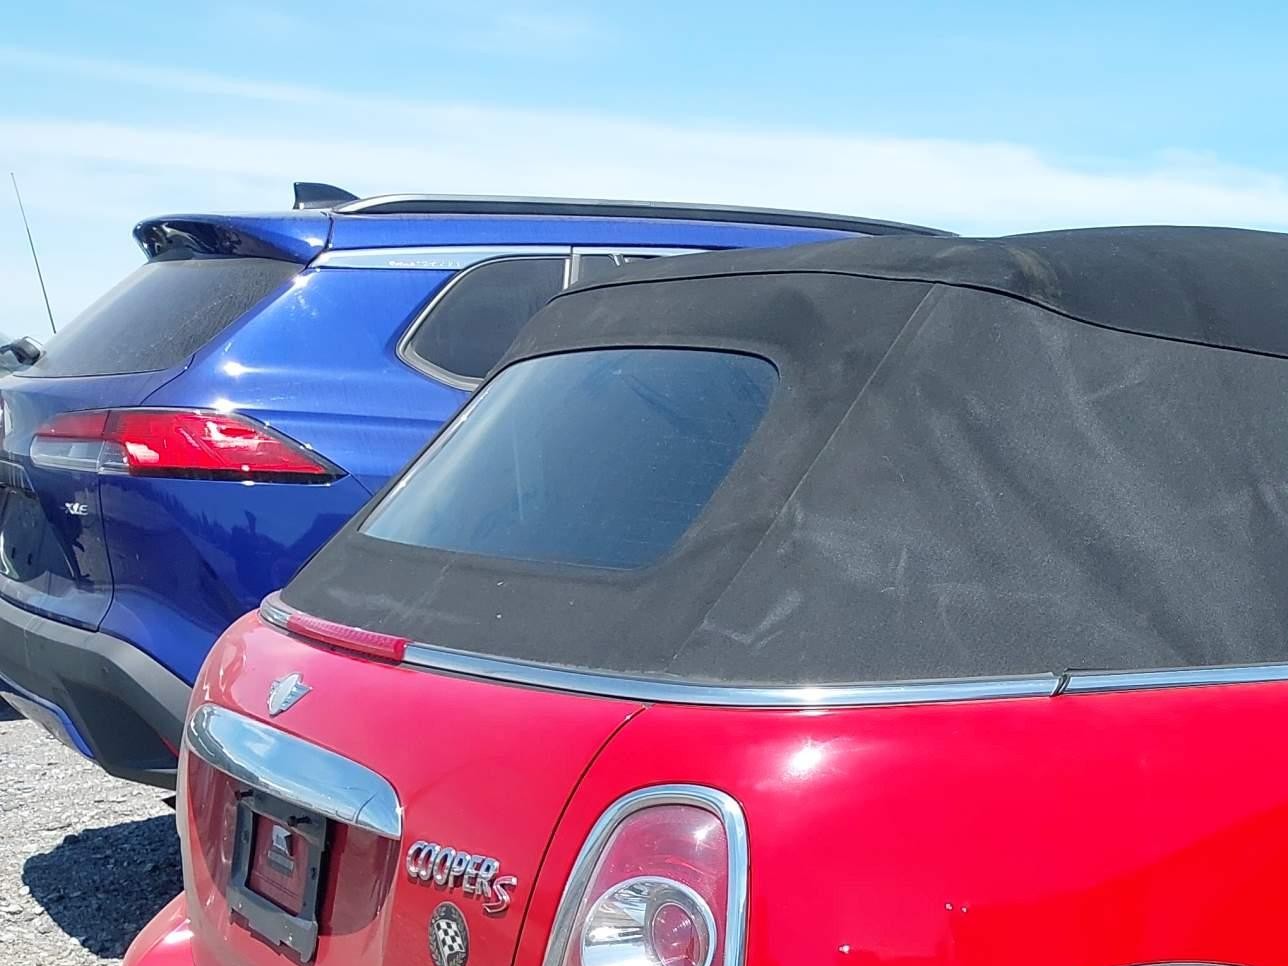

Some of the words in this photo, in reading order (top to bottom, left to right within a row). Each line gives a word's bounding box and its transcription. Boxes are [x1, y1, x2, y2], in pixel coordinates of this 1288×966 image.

[65, 502, 89, 516] XLE
[406, 840, 500, 898] COOPER
[482, 875, 518, 913] S
